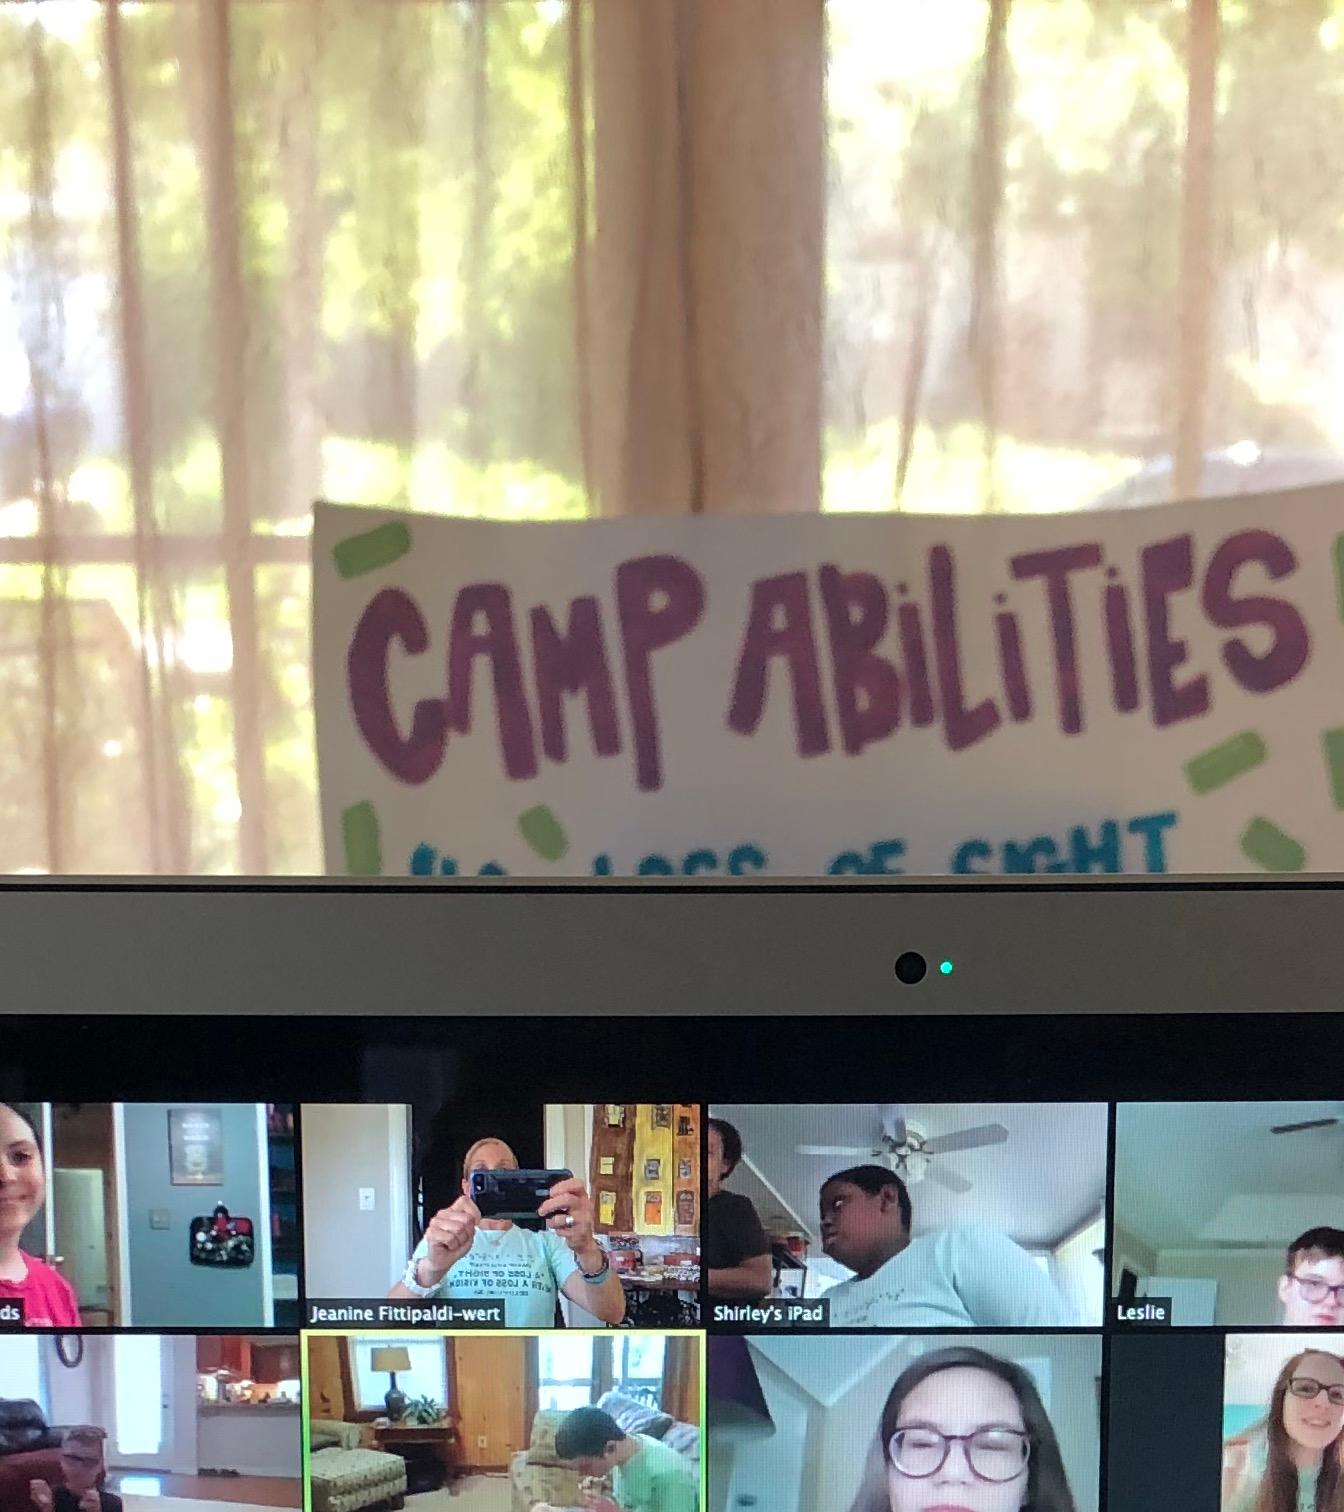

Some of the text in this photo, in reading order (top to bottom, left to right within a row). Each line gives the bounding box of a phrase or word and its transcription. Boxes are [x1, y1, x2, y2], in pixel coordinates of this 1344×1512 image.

[347, 553, 707, 792] CAMP
[309, 1305, 501, 1325] Jeanine Fittipaldi-wert
[713, 1304, 823, 1324] Shirley's iPad
[1117, 1303, 1165, 1320] Leslie
